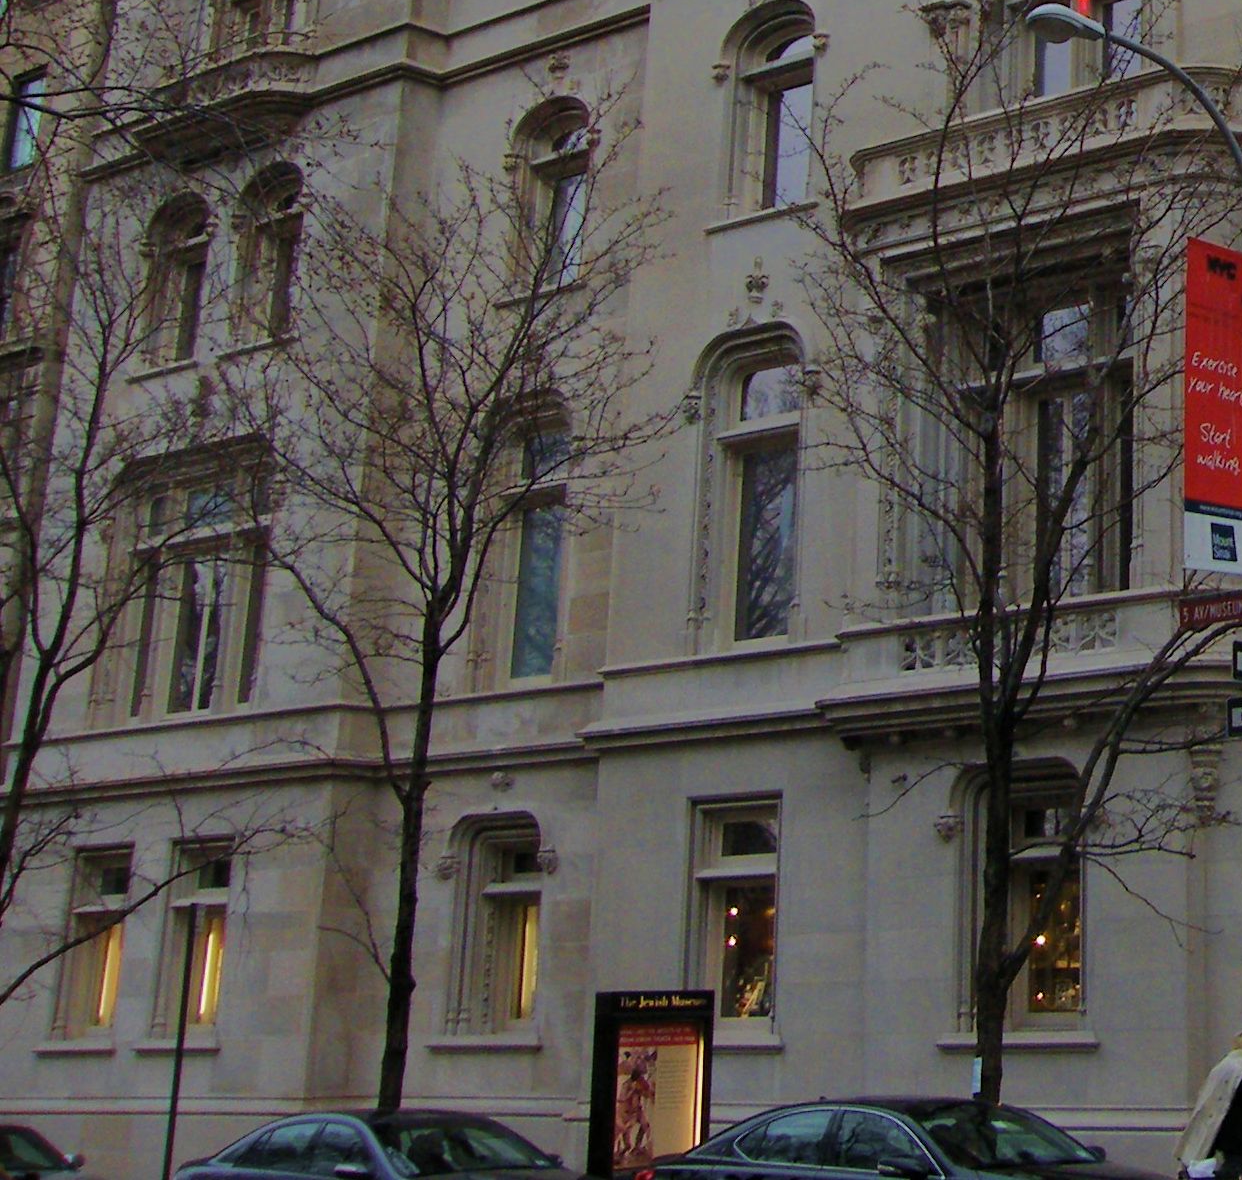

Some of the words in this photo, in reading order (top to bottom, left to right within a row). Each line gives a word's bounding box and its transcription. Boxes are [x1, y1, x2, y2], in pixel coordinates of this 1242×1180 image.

[1191, 351, 1239, 378] Exercise
[1188, 377, 1215, 394] your
[1200, 422, 1232, 449] Start
[1196, 451, 1241, 476] walking
[1182, 607, 1190, 623] 5
[639, 995, 669, 1009] Jewish
